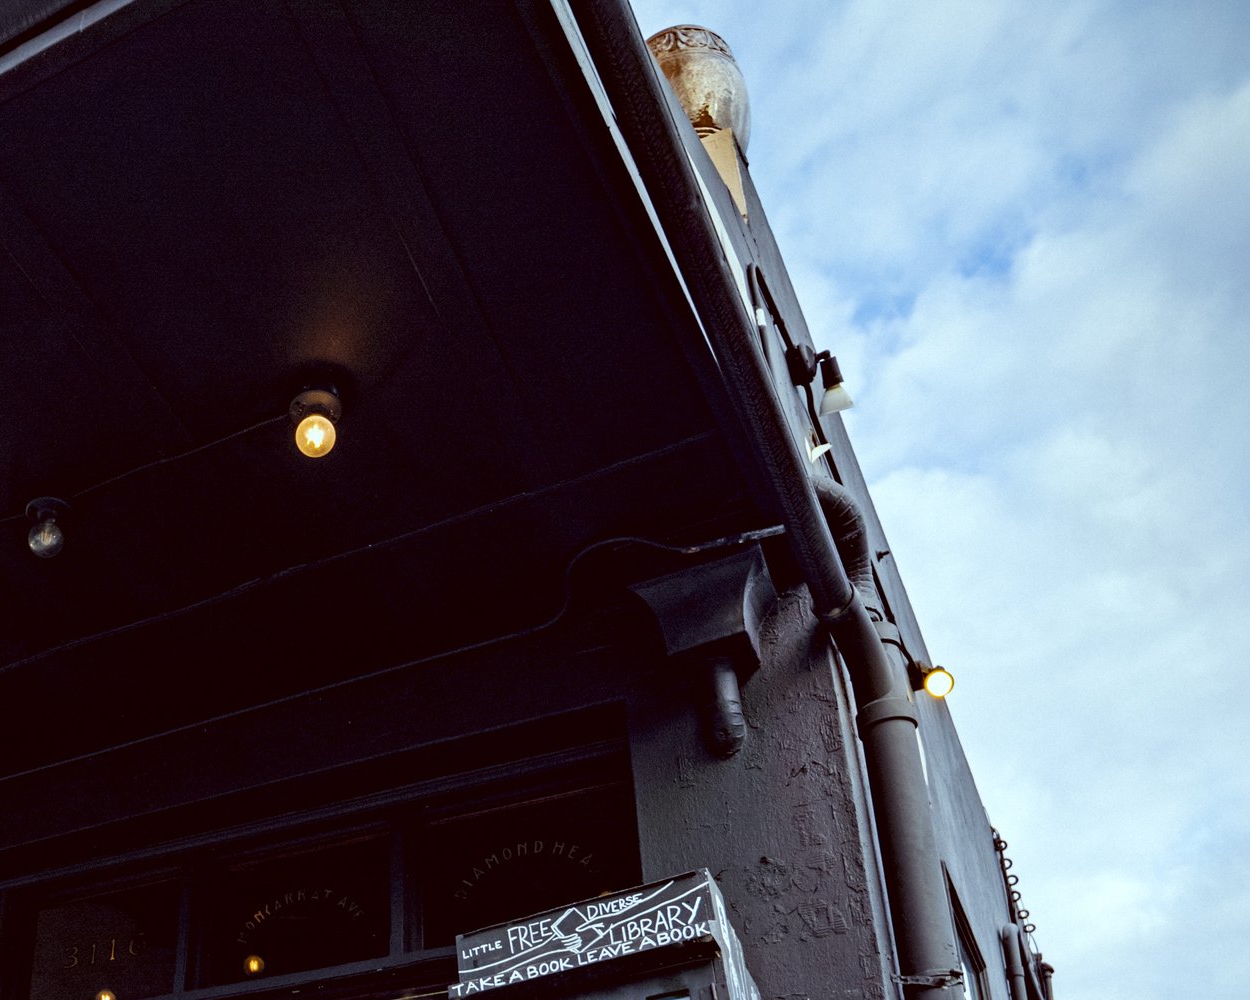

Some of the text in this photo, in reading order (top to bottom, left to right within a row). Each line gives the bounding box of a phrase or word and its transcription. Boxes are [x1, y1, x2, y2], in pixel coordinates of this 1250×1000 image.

[454, 840, 544, 900] DIAMOND
[462, 897, 701, 959] LITTLE FREE LIBRARY
[587, 893, 643, 920] DIVERSE
[452, 922, 711, 996] TAKE A BOOK LEAVE A BOOK
